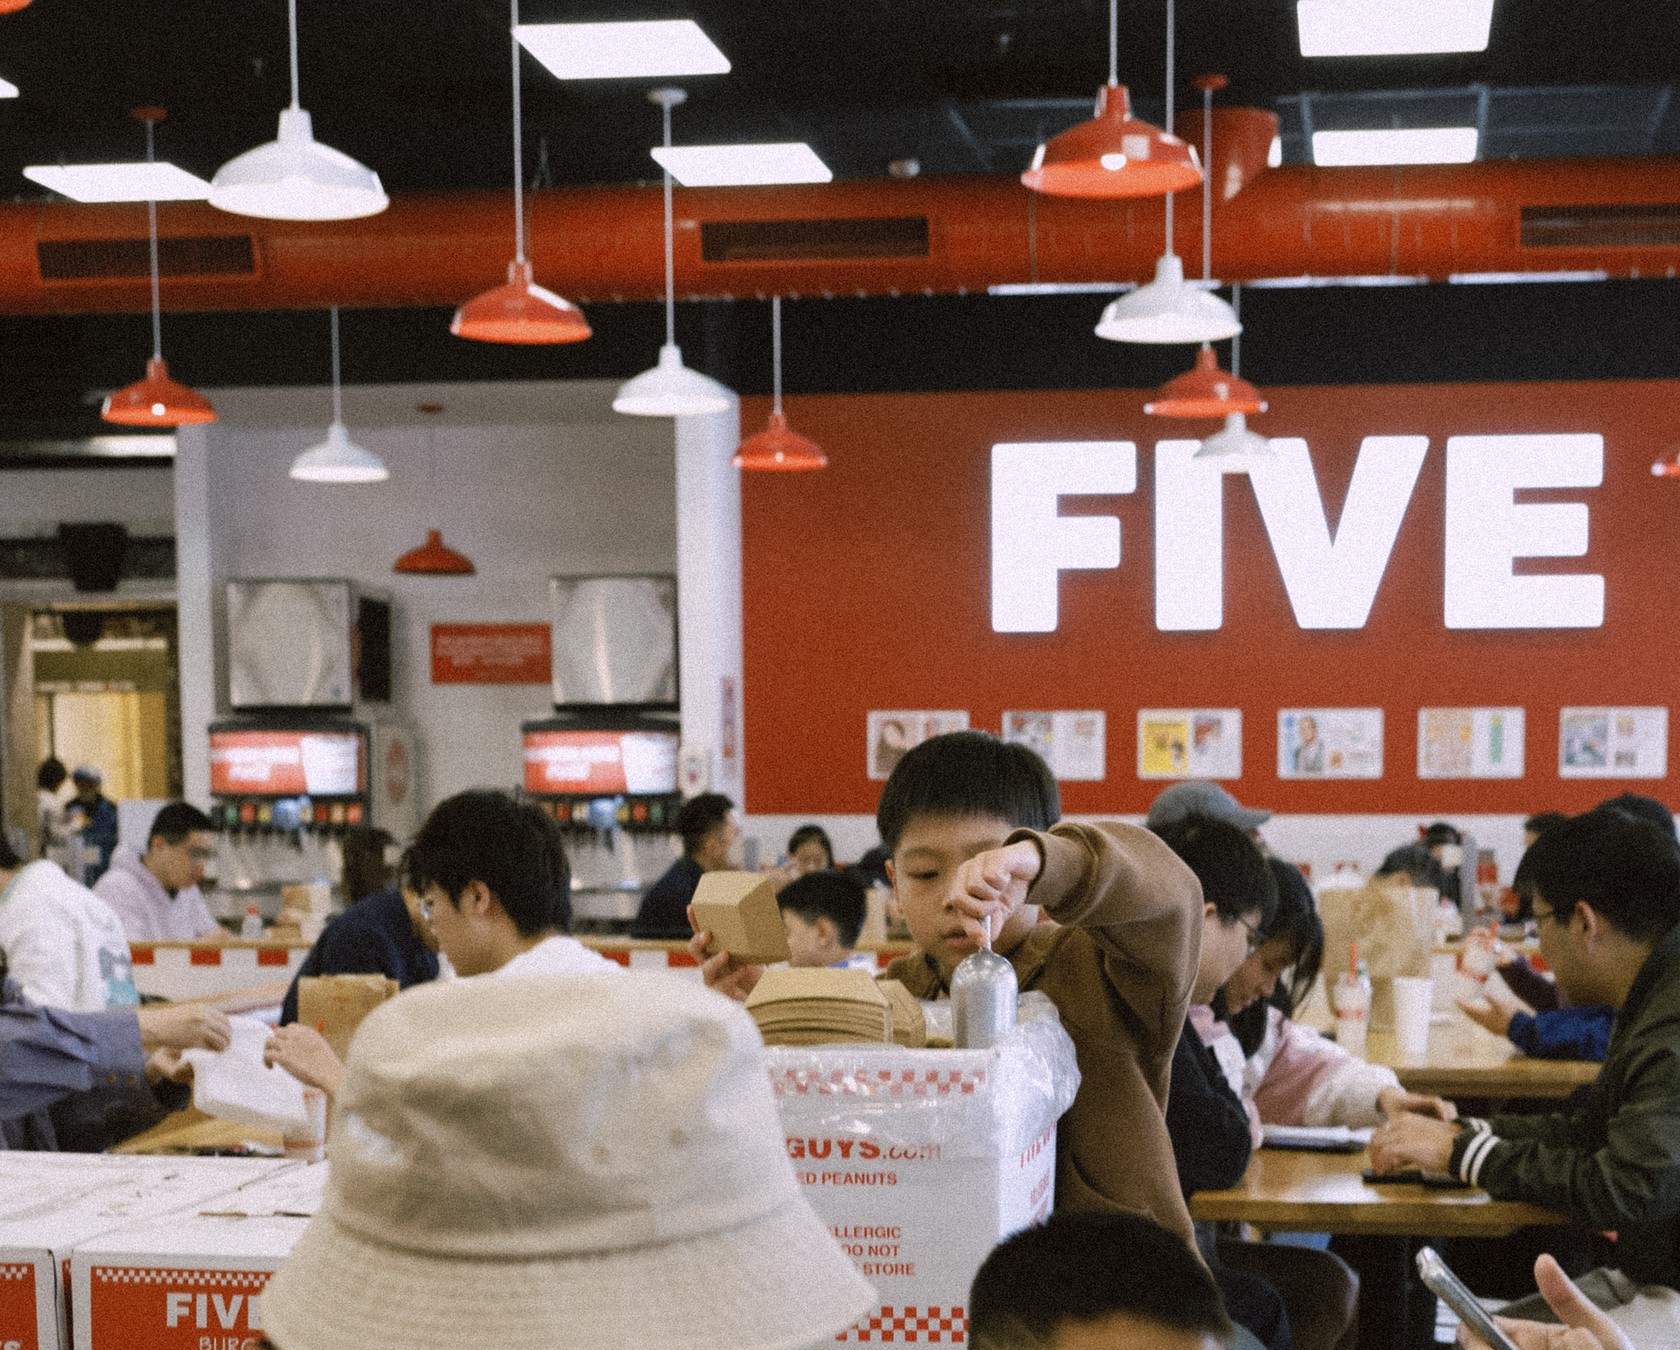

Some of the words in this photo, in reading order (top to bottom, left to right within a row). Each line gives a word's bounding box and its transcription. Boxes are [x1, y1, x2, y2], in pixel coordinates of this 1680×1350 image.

[991, 433, 1605, 633] FIVE
[821, 1171, 898, 1186] PEANUTS
[828, 1225, 902, 1240] LLERGIC
[868, 1244, 901, 1257] NOT
[863, 1262, 916, 1276] STORE
